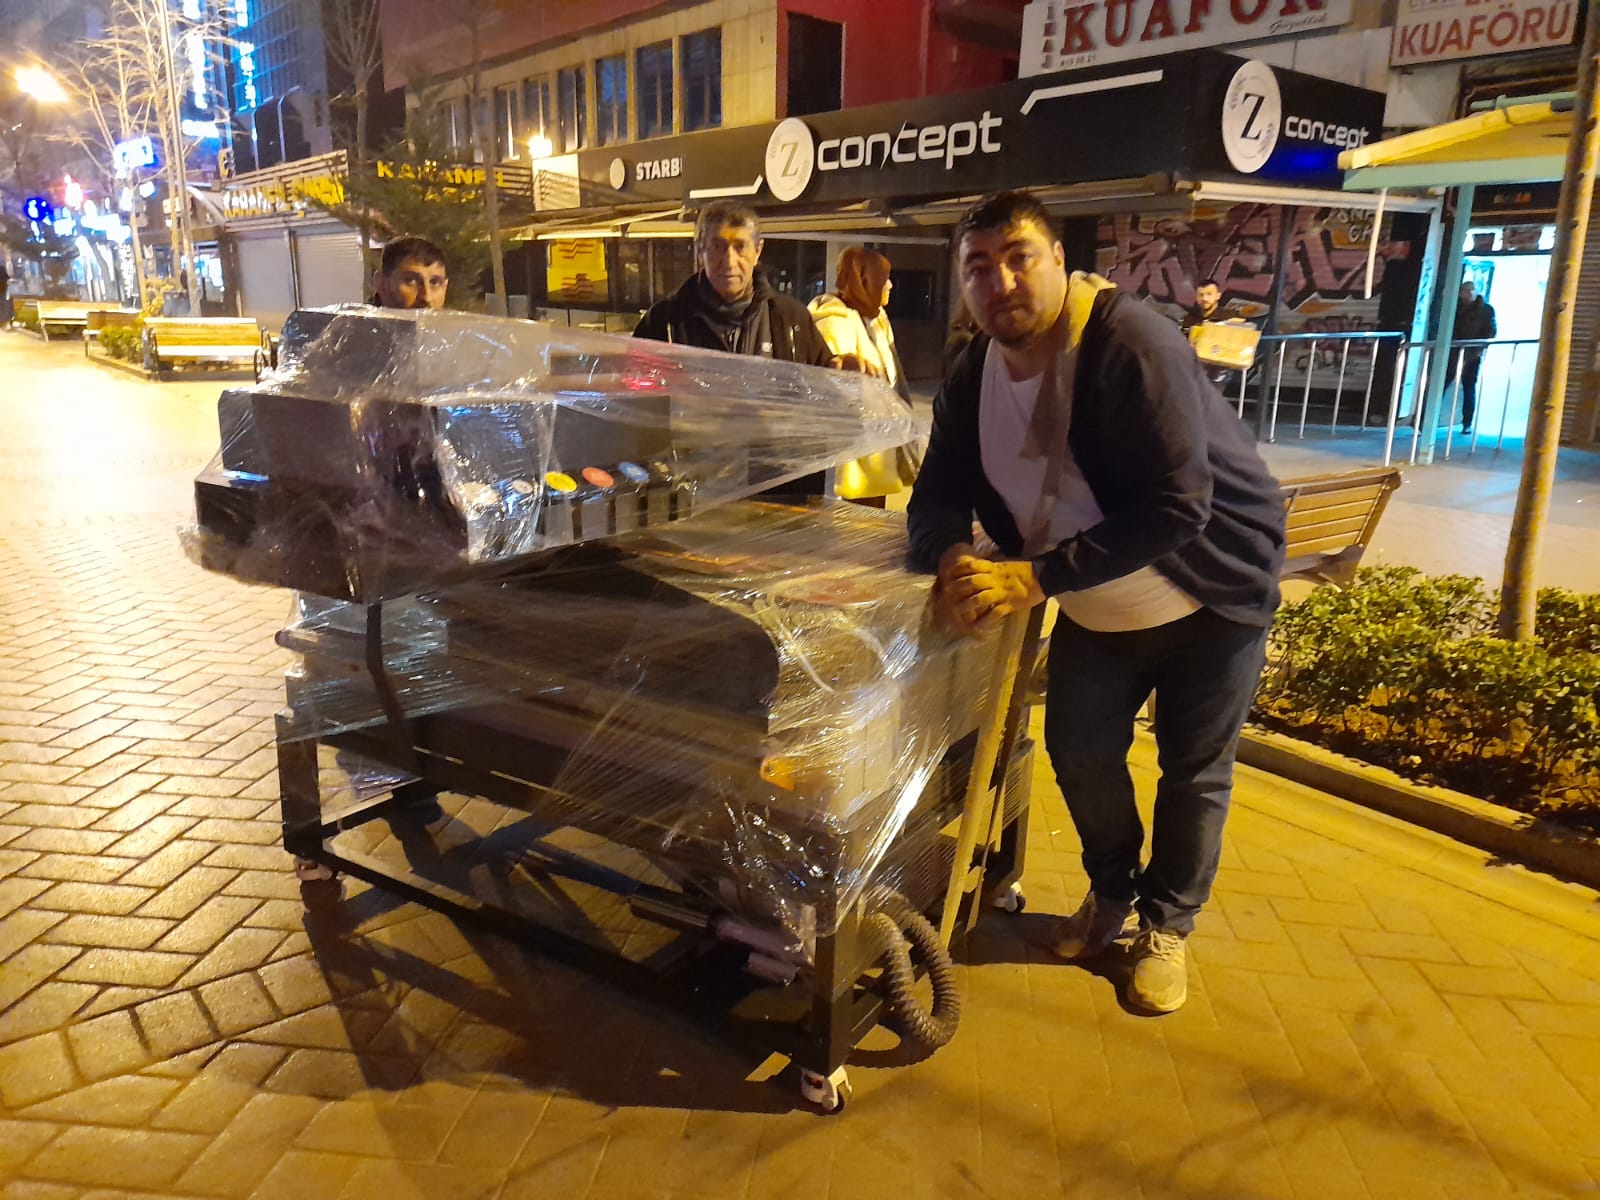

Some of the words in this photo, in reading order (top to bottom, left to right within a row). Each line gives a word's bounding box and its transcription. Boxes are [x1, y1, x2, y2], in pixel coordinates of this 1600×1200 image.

[781, 142, 799, 178] Z
[817, 110, 1003, 171] concept
[1240, 92, 1265, 140] Z
[1285, 115, 1369, 151] concept
[636, 156, 683, 181] STARB
